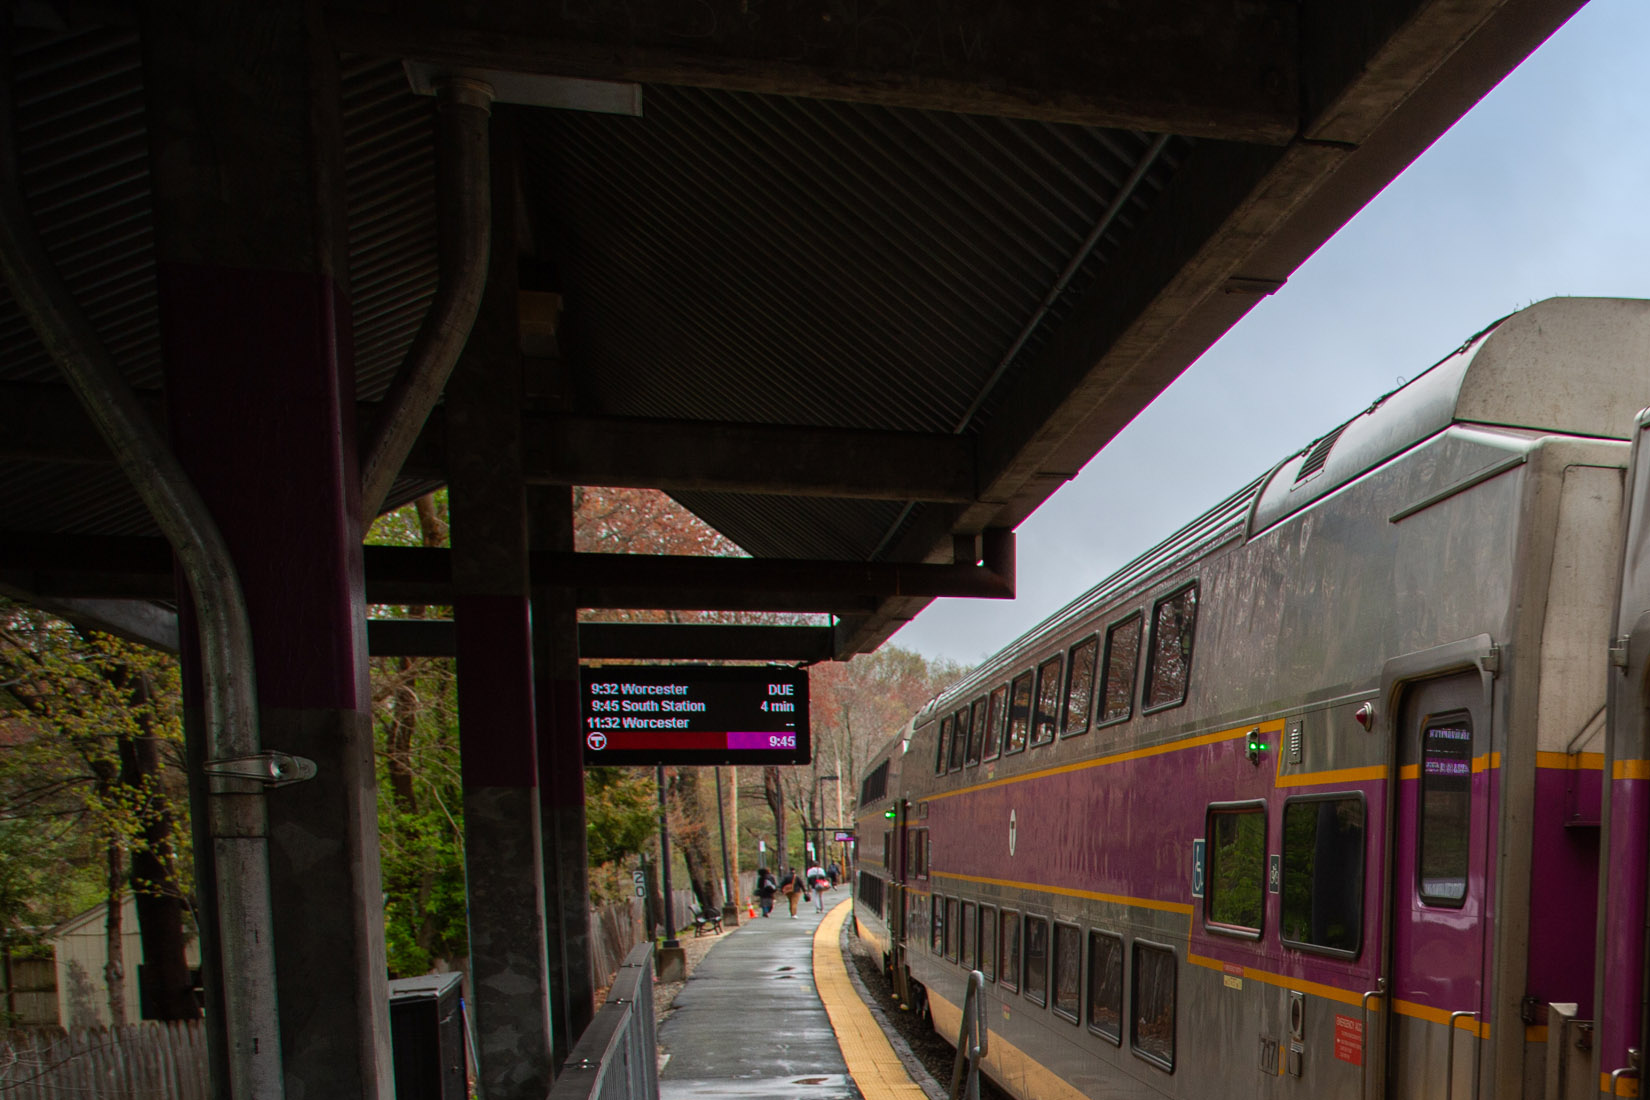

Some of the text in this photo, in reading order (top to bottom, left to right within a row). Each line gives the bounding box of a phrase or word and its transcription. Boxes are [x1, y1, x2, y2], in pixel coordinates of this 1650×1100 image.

[591, 683, 689, 695] 9:32 Worcester
[768, 683, 794, 695] DUE
[592, 699, 706, 712] 9:45 South Station
[760, 700, 795, 712] 4 min
[587, 716, 690, 729] 11:32 Worcester
[769, 736, 796, 747] 9:45
